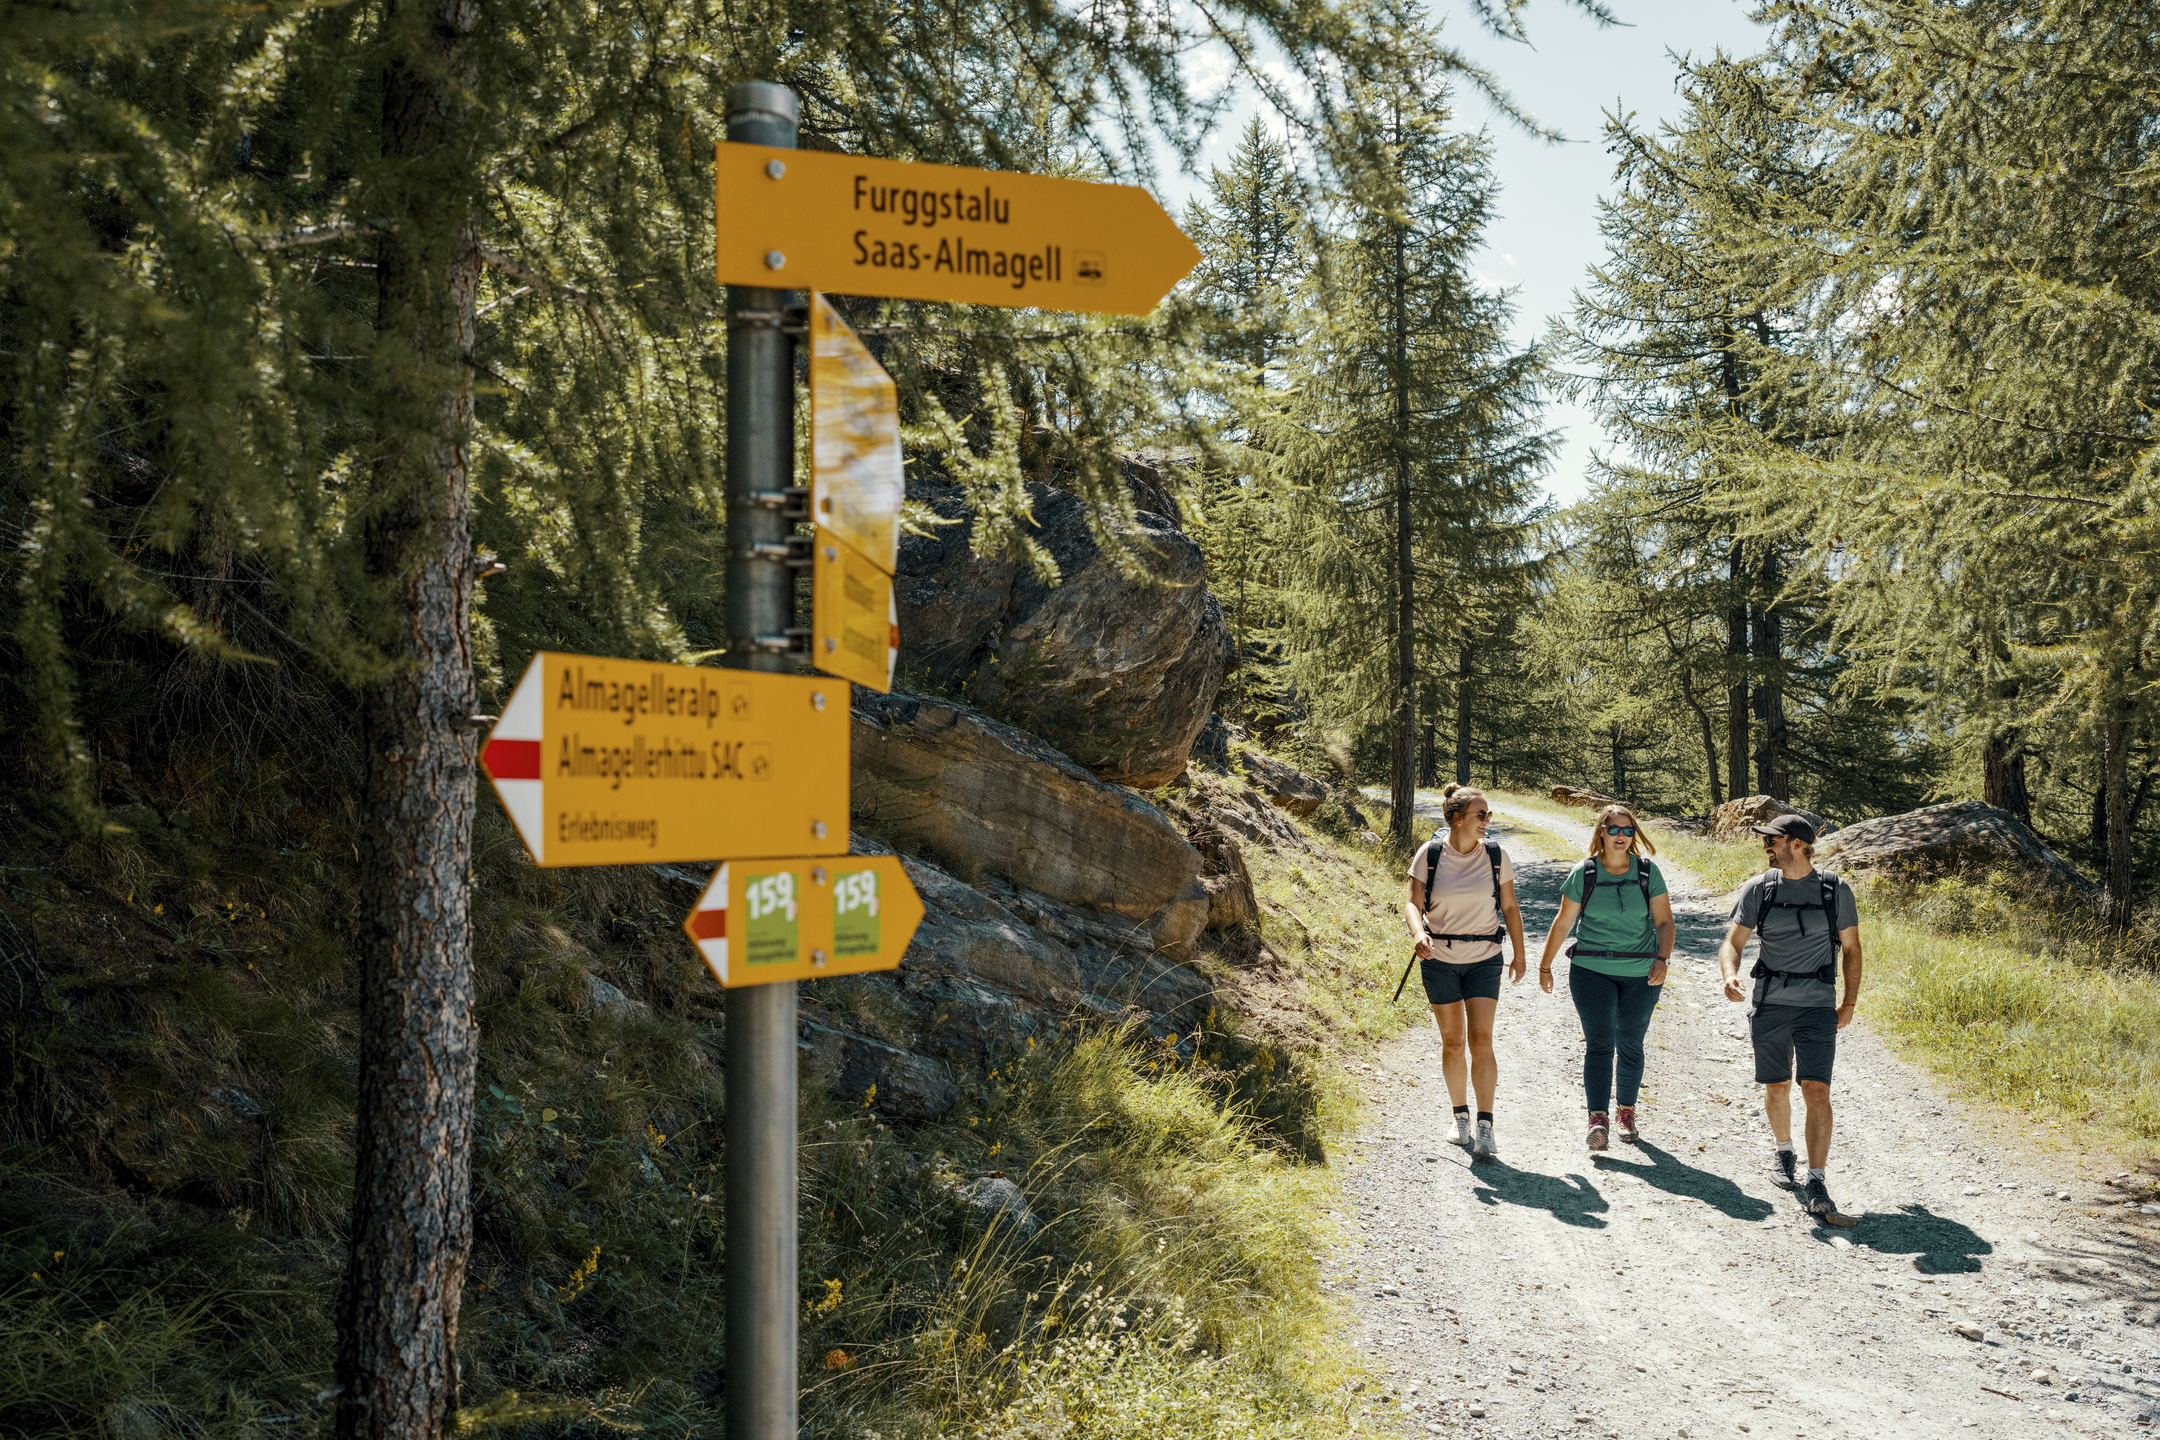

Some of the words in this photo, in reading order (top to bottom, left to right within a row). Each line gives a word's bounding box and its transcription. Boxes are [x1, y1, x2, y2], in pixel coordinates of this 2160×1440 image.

[853, 175, 1010, 226] Furggstalu
[853, 230, 1061, 288] Saas-Almagell
[558, 665, 719, 728] Almagelleralp
[712, 740, 745, 780] SAC
[559, 811, 658, 848] Erlebnisweg
[745, 871, 796, 921] 159
[833, 870, 877, 917] 159
